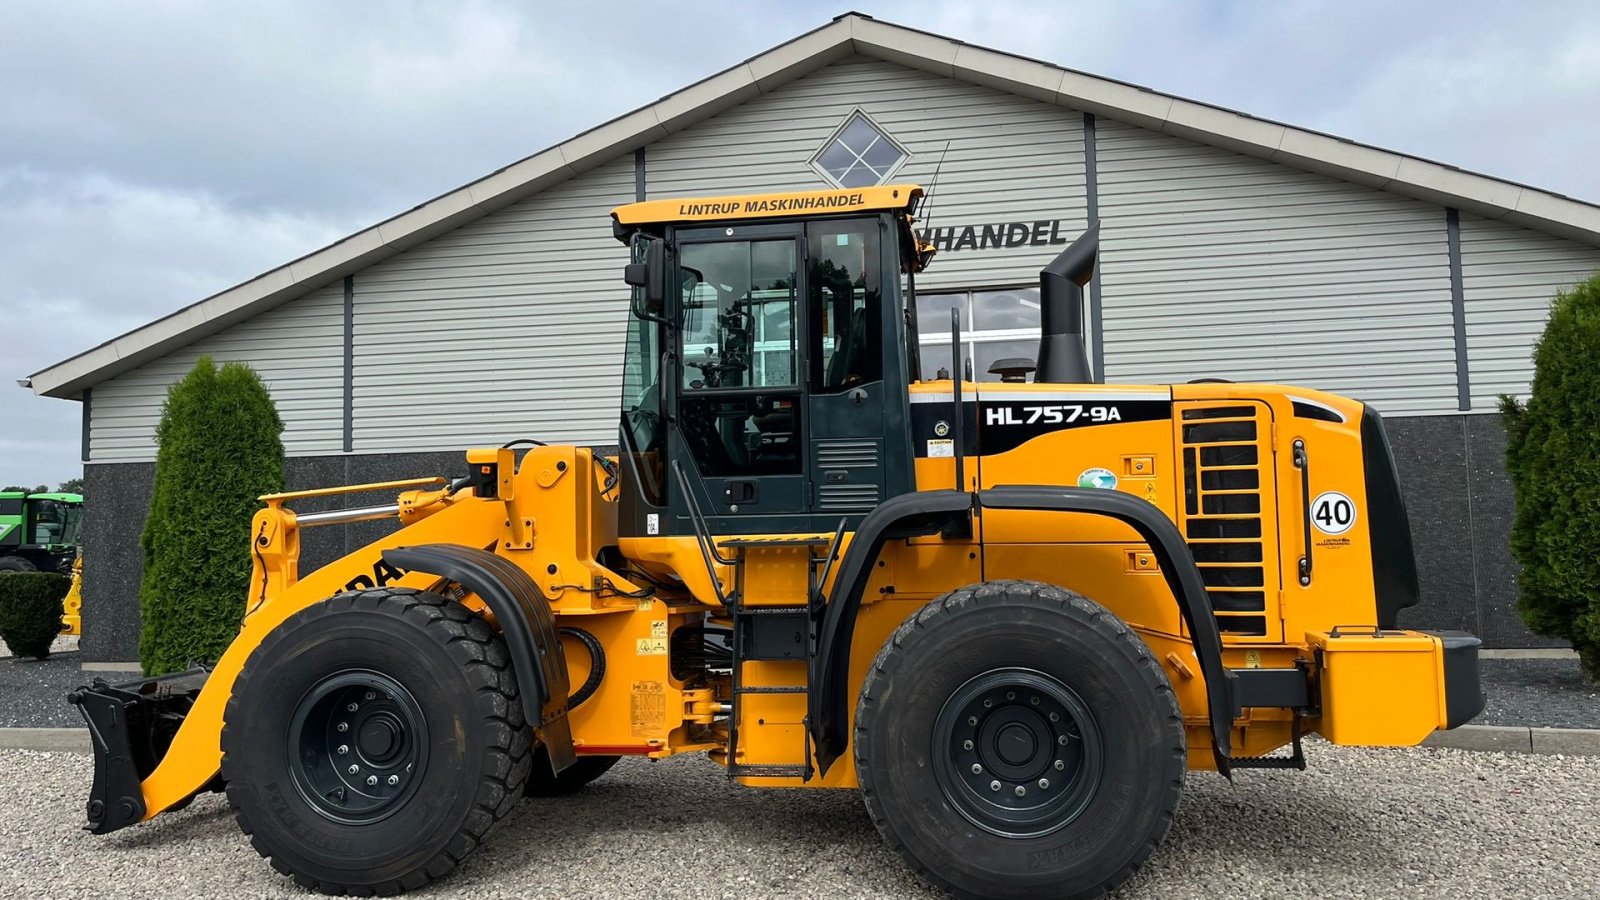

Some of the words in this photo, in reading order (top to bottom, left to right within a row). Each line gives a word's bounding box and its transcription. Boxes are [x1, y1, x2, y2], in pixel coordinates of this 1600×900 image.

[679, 203, 740, 216] LINTRUP
[744, 193, 865, 213] MASKINHANDEL
[1316, 499, 1351, 526] 40
